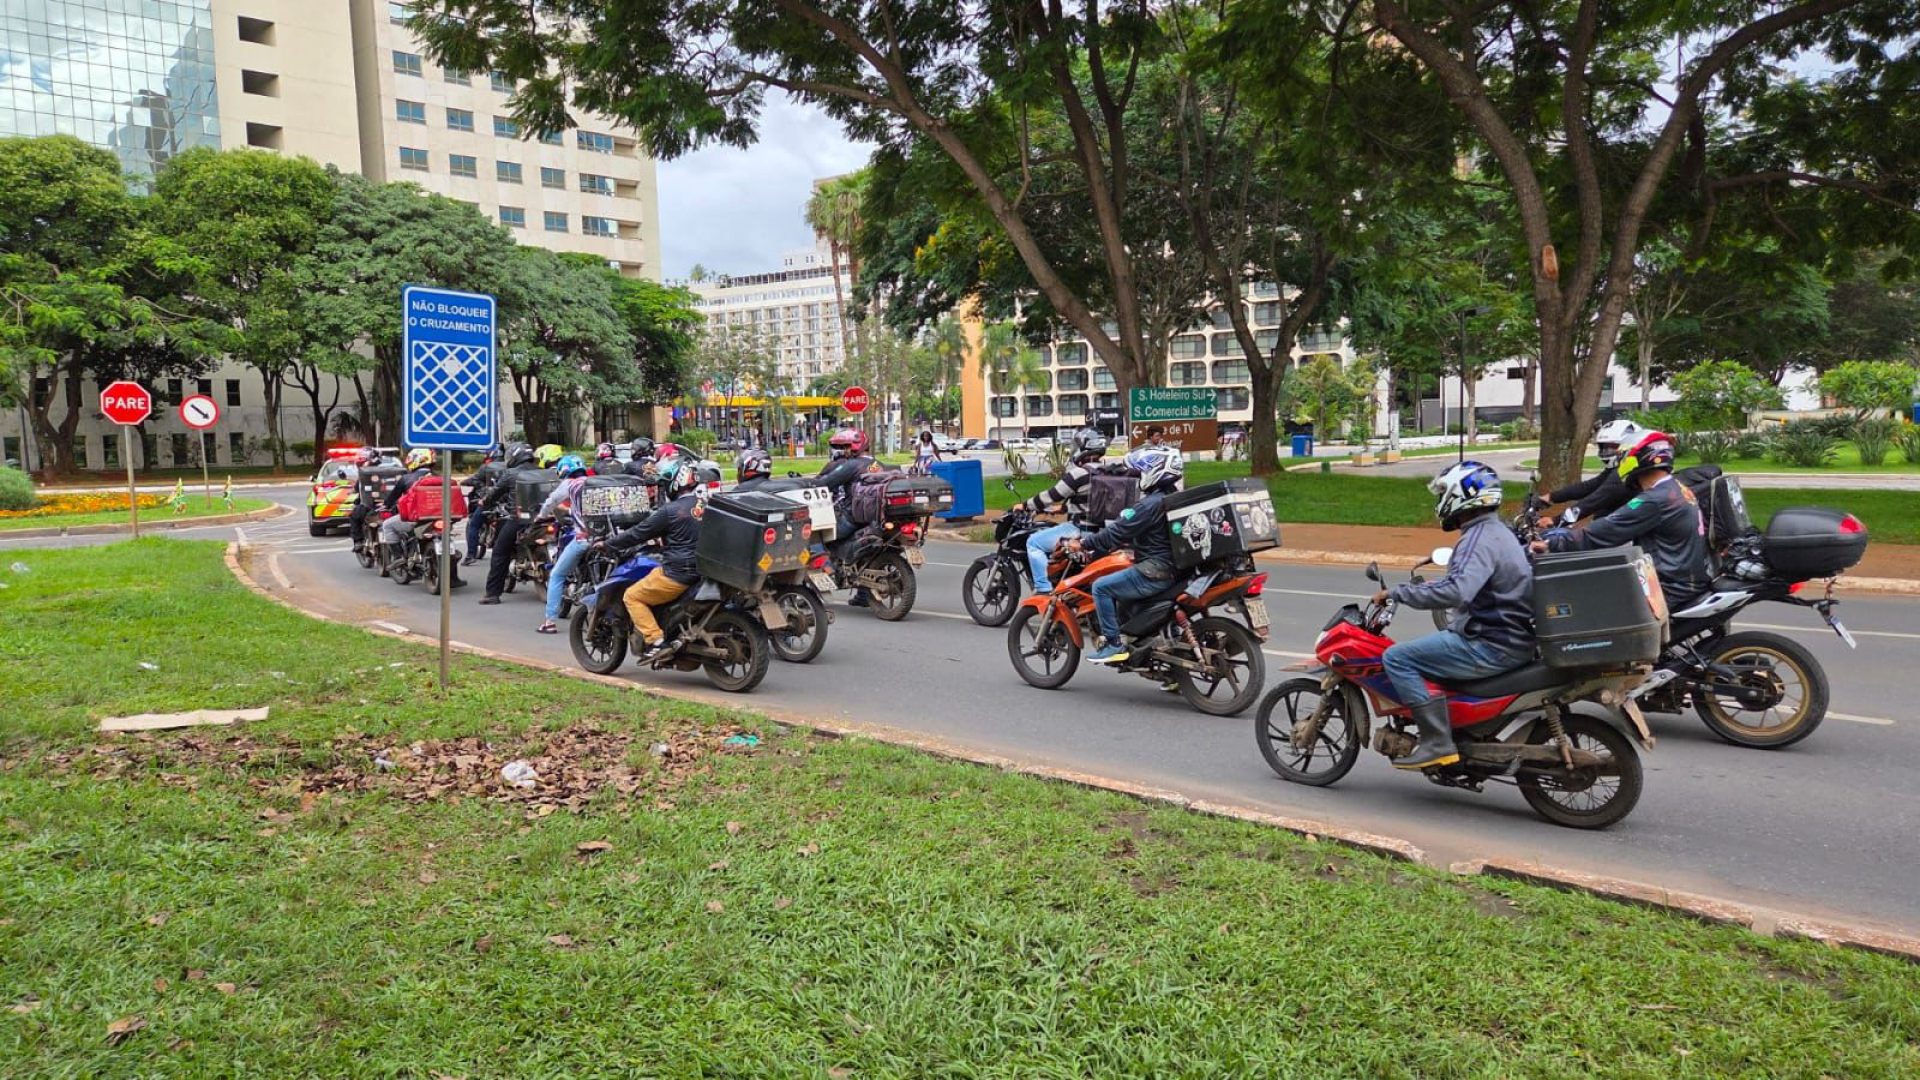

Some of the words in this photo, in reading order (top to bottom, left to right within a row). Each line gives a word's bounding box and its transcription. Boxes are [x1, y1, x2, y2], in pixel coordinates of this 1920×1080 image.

[412, 300, 435, 313] NÃO
[437, 303, 489, 319] BLOQUEIE
[408, 316, 417, 327] O
[420, 318, 490, 334] CRUZAMENTO
[844, 395, 866, 404] PARE
[1150, 389, 1190, 401] Hoteleiro
[1192, 389, 1206, 401] Sul
[105, 397, 147, 409] PARE
[1145, 404, 1190, 417] Comercial
[1192, 404, 1206, 416] Sul
[1169, 423, 1181, 436] de
[1183, 422, 1195, 434] TV
